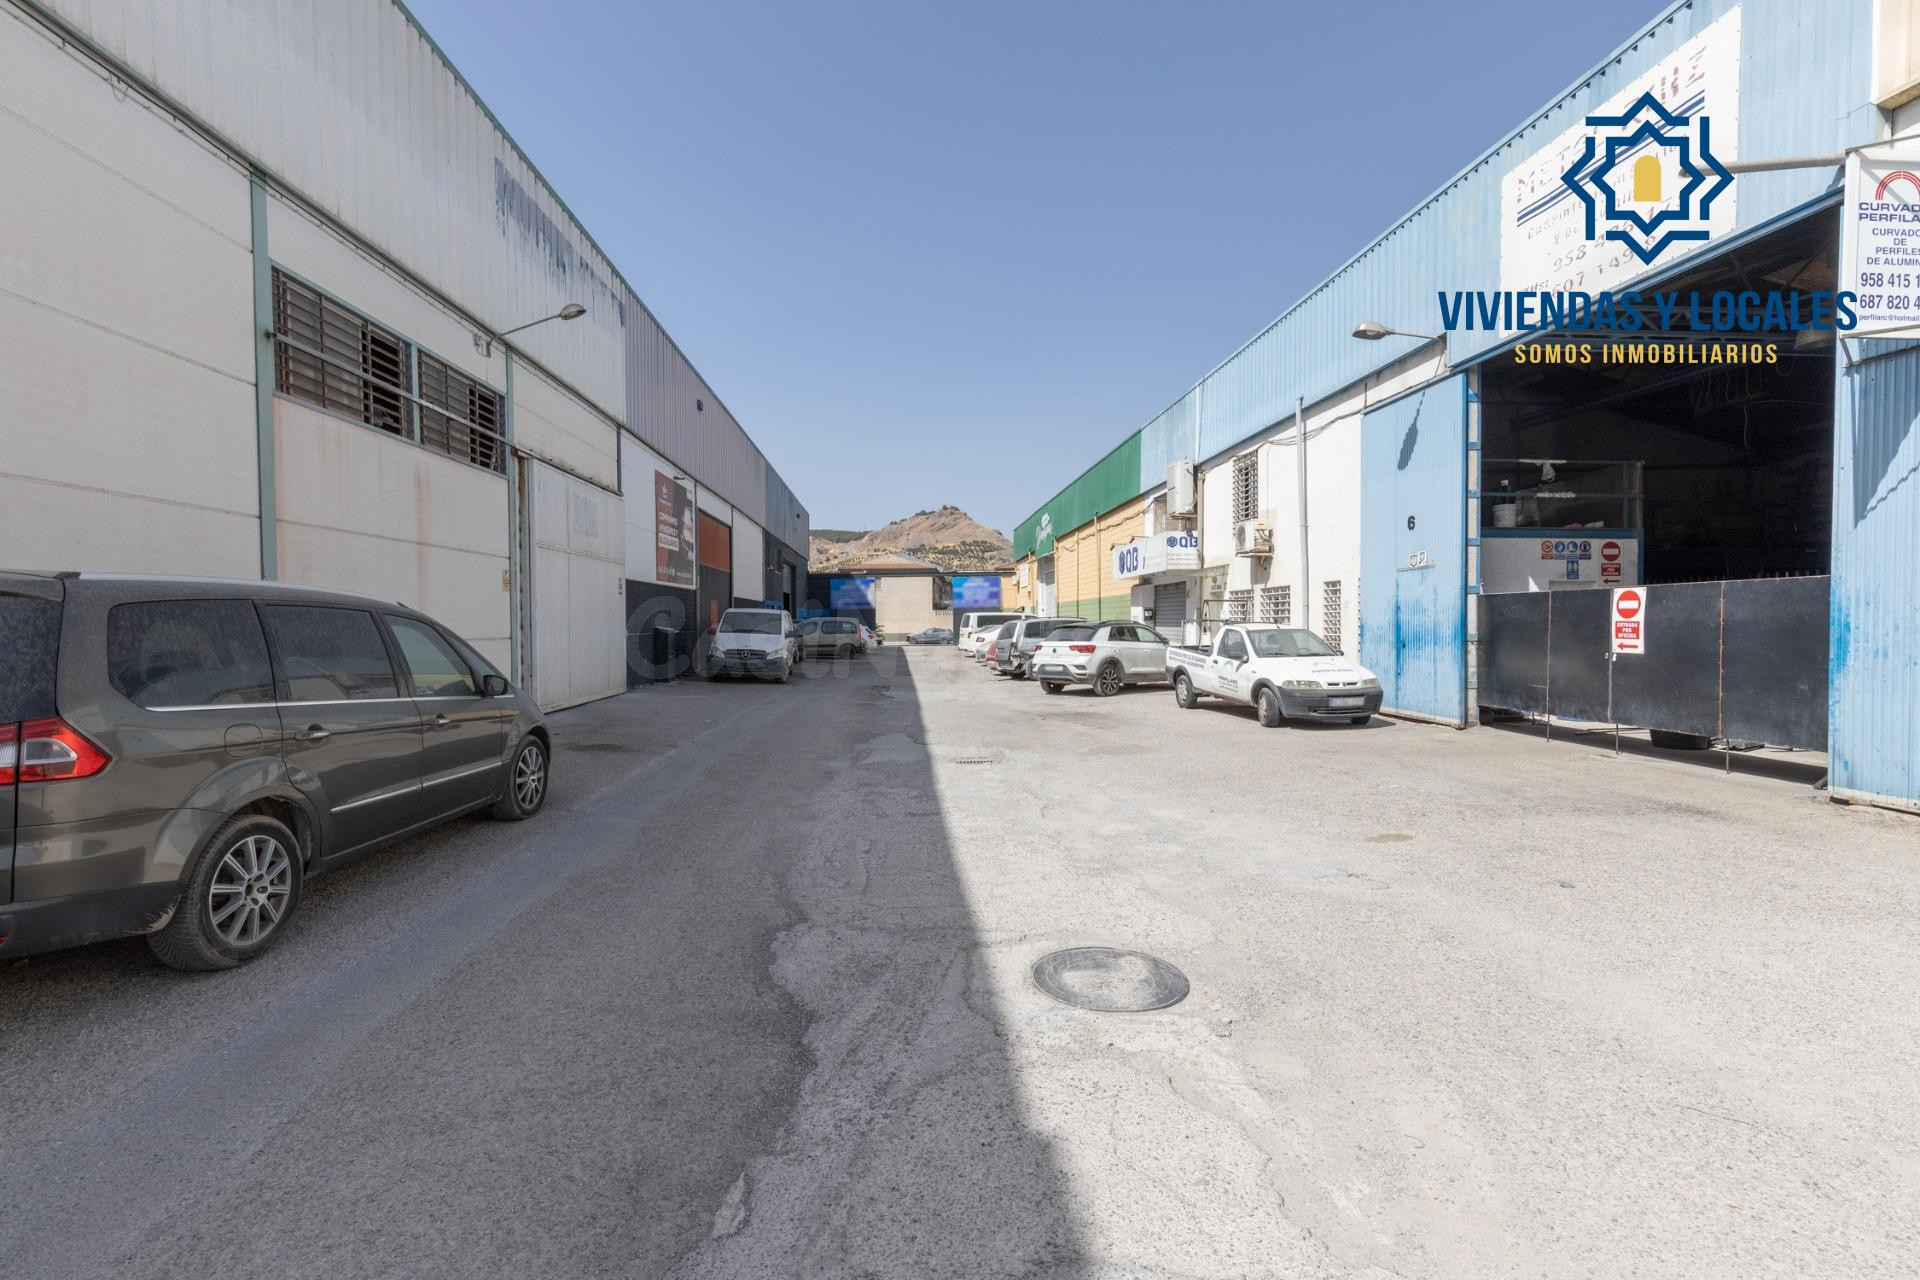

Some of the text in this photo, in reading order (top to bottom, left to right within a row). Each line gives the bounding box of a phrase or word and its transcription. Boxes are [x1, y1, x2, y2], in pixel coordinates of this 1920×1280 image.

[1893, 238, 1907, 246] DE
[1866, 257, 1881, 265] DE
[1860, 272, 1884, 288] 958
[1887, 273, 1911, 289] 415
[1859, 294, 1883, 309] 687
[1887, 295, 1910, 310] 820
[1407, 515, 1416, 531] 6
[1179, 536, 1198, 548] QB
[1125, 546, 1139, 573] QB
